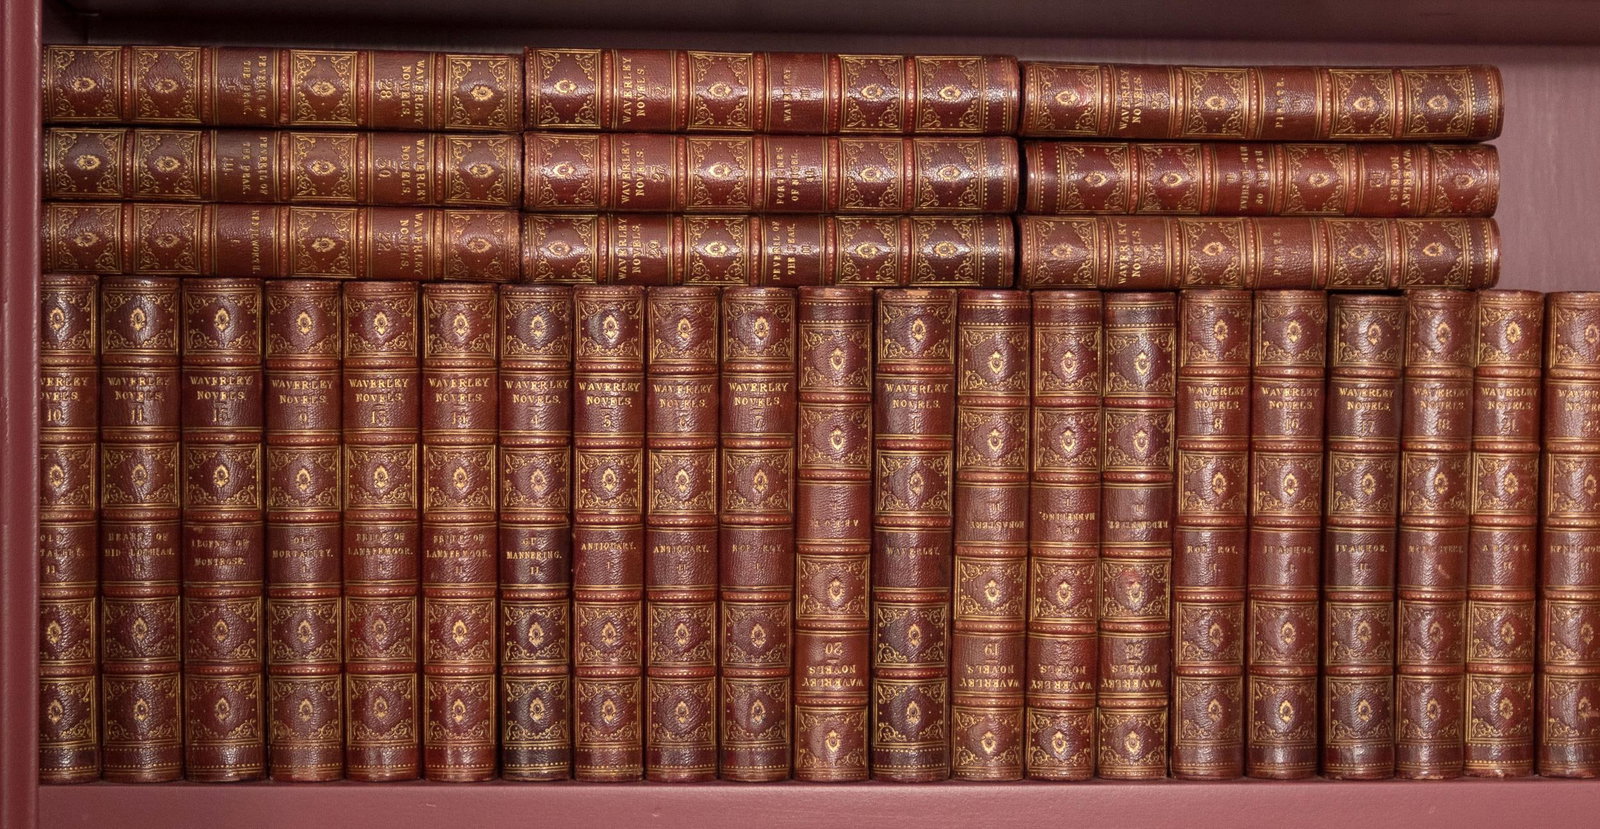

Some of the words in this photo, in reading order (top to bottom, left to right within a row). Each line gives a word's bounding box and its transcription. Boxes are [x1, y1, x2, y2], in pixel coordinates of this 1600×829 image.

[243, 61, 251, 79] THE
[258, 55, 267, 101] PEVERIL
[400, 65, 412, 118] NOVELS.
[414, 60, 425, 125] WAVERLEY
[622, 57, 632, 124] WAVERLEY
[636, 65, 646, 117] NOVELS.
[1119, 70, 1130, 130] WAVERLEY
[1132, 74, 1142, 124] NOVELS.
[242, 142, 250, 160] THE
[258, 136, 267, 181] PEVERIL
[400, 145, 411, 196] NOVELS.
[415, 138, 425, 202] WAVERLEY
[621, 140, 631, 204] WAVERLEY
[636, 148, 645, 196] NOVELS.
[1389, 156, 1399, 202] NOVELS.
[1401, 149, 1411, 208] WAVERLEY
[791, 189, 799, 202] OF
[773, 221, 782, 231] OF
[400, 219, 409, 270] NOVELS.
[413, 212, 424, 275] WAVERLEY
[618, 217, 628, 280] WAVERLEY
[632, 223, 641, 274] NOVELS.
[1117, 221, 1130, 284] WAVERLEY
[1132, 227, 1141, 277] NOVELS.
[772, 234, 781, 281] PEVERIL
[787, 257, 796, 275] THE
[107, 377, 169, 387] WAVERLEY
[189, 376, 253, 386] WAVERLEY
[272, 379, 334, 390] WAVERLEY
[349, 378, 409, 388] WAVERLEY
[428, 378, 490, 388] WAVERLEY
[505, 380, 568, 390] WAVERLEY
[579, 382, 640, 392] WAVERLEY
[653, 384, 713, 394] WAVERLEY
[728, 382, 788, 392] WAVERLEY
[884, 383, 949, 394] WAVERLEY
[1187, 386, 1246, 396] WAVERLEY
[1261, 386, 1320, 397] WAVERLEY
[115, 391, 165, 401] NOVELS.
[197, 391, 247, 401] NOVELS.
[1338, 387, 1394, 398] WAVERLEY
[279, 395, 329, 405] NOVELS.
[355, 393, 404, 403] NOVELS.
[435, 393, 485, 403] NOVELS.
[512, 394, 561, 404] NOVELS.
[586, 396, 633, 407] NOVELS.
[734, 397, 783, 407] NOVELS.
[659, 399, 708, 409] NOVELS.
[892, 399, 941, 409] NOVELS.
[1194, 400, 1241, 411] NOVELS.
[1269, 401, 1315, 411] NOVELS.
[1347, 401, 1391, 411] NOVELS.
[581, 541, 637, 550] ANTIQUARY.
[426, 549, 491, 559] LAMMERMOOR.
[506, 550, 563, 560] MANNERING.
[194, 557, 246, 566] MONTROSE.
[807, 664, 856, 674] NOVELS.
[966, 664, 1014, 674] NOVELS.
[1039, 665, 1086, 675] NOVELS.
[1112, 664, 1158, 674] NOVELS.
[802, 678, 864, 687] WAVERLEY
[960, 678, 1019, 688] WAVERLEY
[1031, 679, 1093, 690] WAVERLEY
[1102, 679, 1163, 689] WAVERLEY
